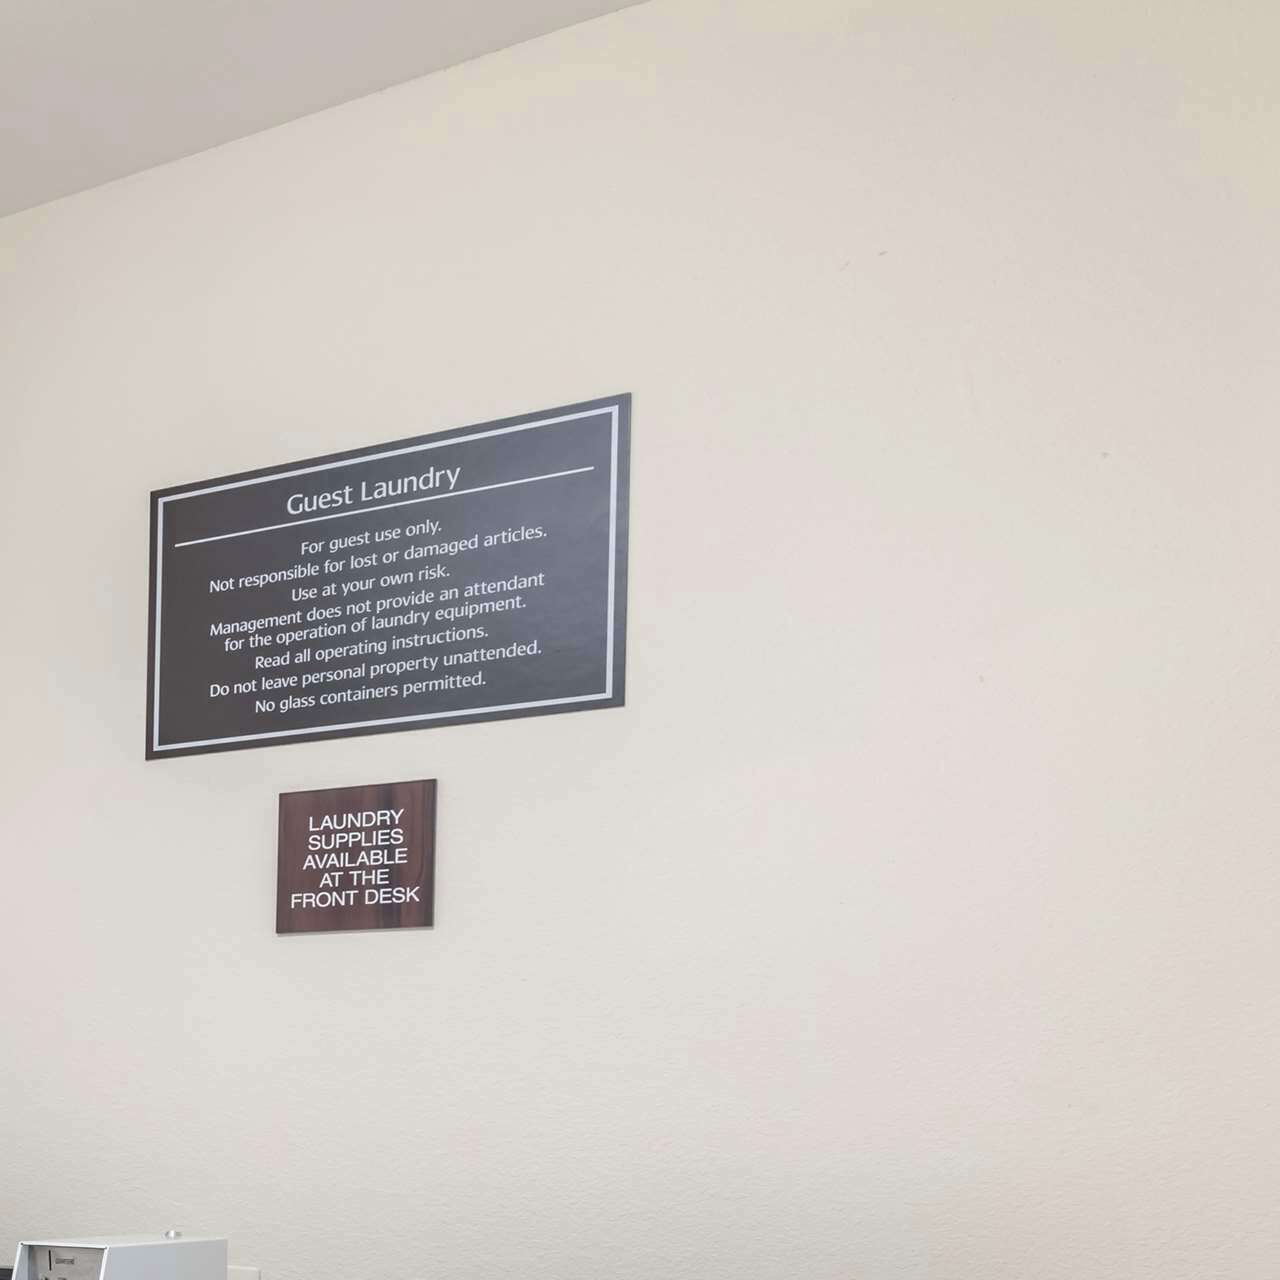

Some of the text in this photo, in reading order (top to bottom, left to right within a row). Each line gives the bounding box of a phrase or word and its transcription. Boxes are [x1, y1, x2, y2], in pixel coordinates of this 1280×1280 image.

[287, 466, 461, 515] Guest Laundry
[301, 519, 442, 555] For guest use only.
[209, 526, 547, 593] Not responsible for lost or damaged articles.
[292, 564, 450, 601] Use at your own risk.
[210, 573, 545, 636] Management does not provide an attendant
[224, 595, 526, 652] for the operation of laundry equipment.
[255, 626, 489, 669] Read all operating instructions.
[210, 640, 542, 697] Do not leave personal property unattended.
[255, 671, 486, 713] No glass containers permitted.
[308, 828, 404, 850] SUPPLIES
[309, 808, 405, 831] LAUNDRY
[302, 848, 408, 870] AVAILABLE
[319, 868, 389, 888] AT THE
[291, 886, 420, 908] FRONT DESK
